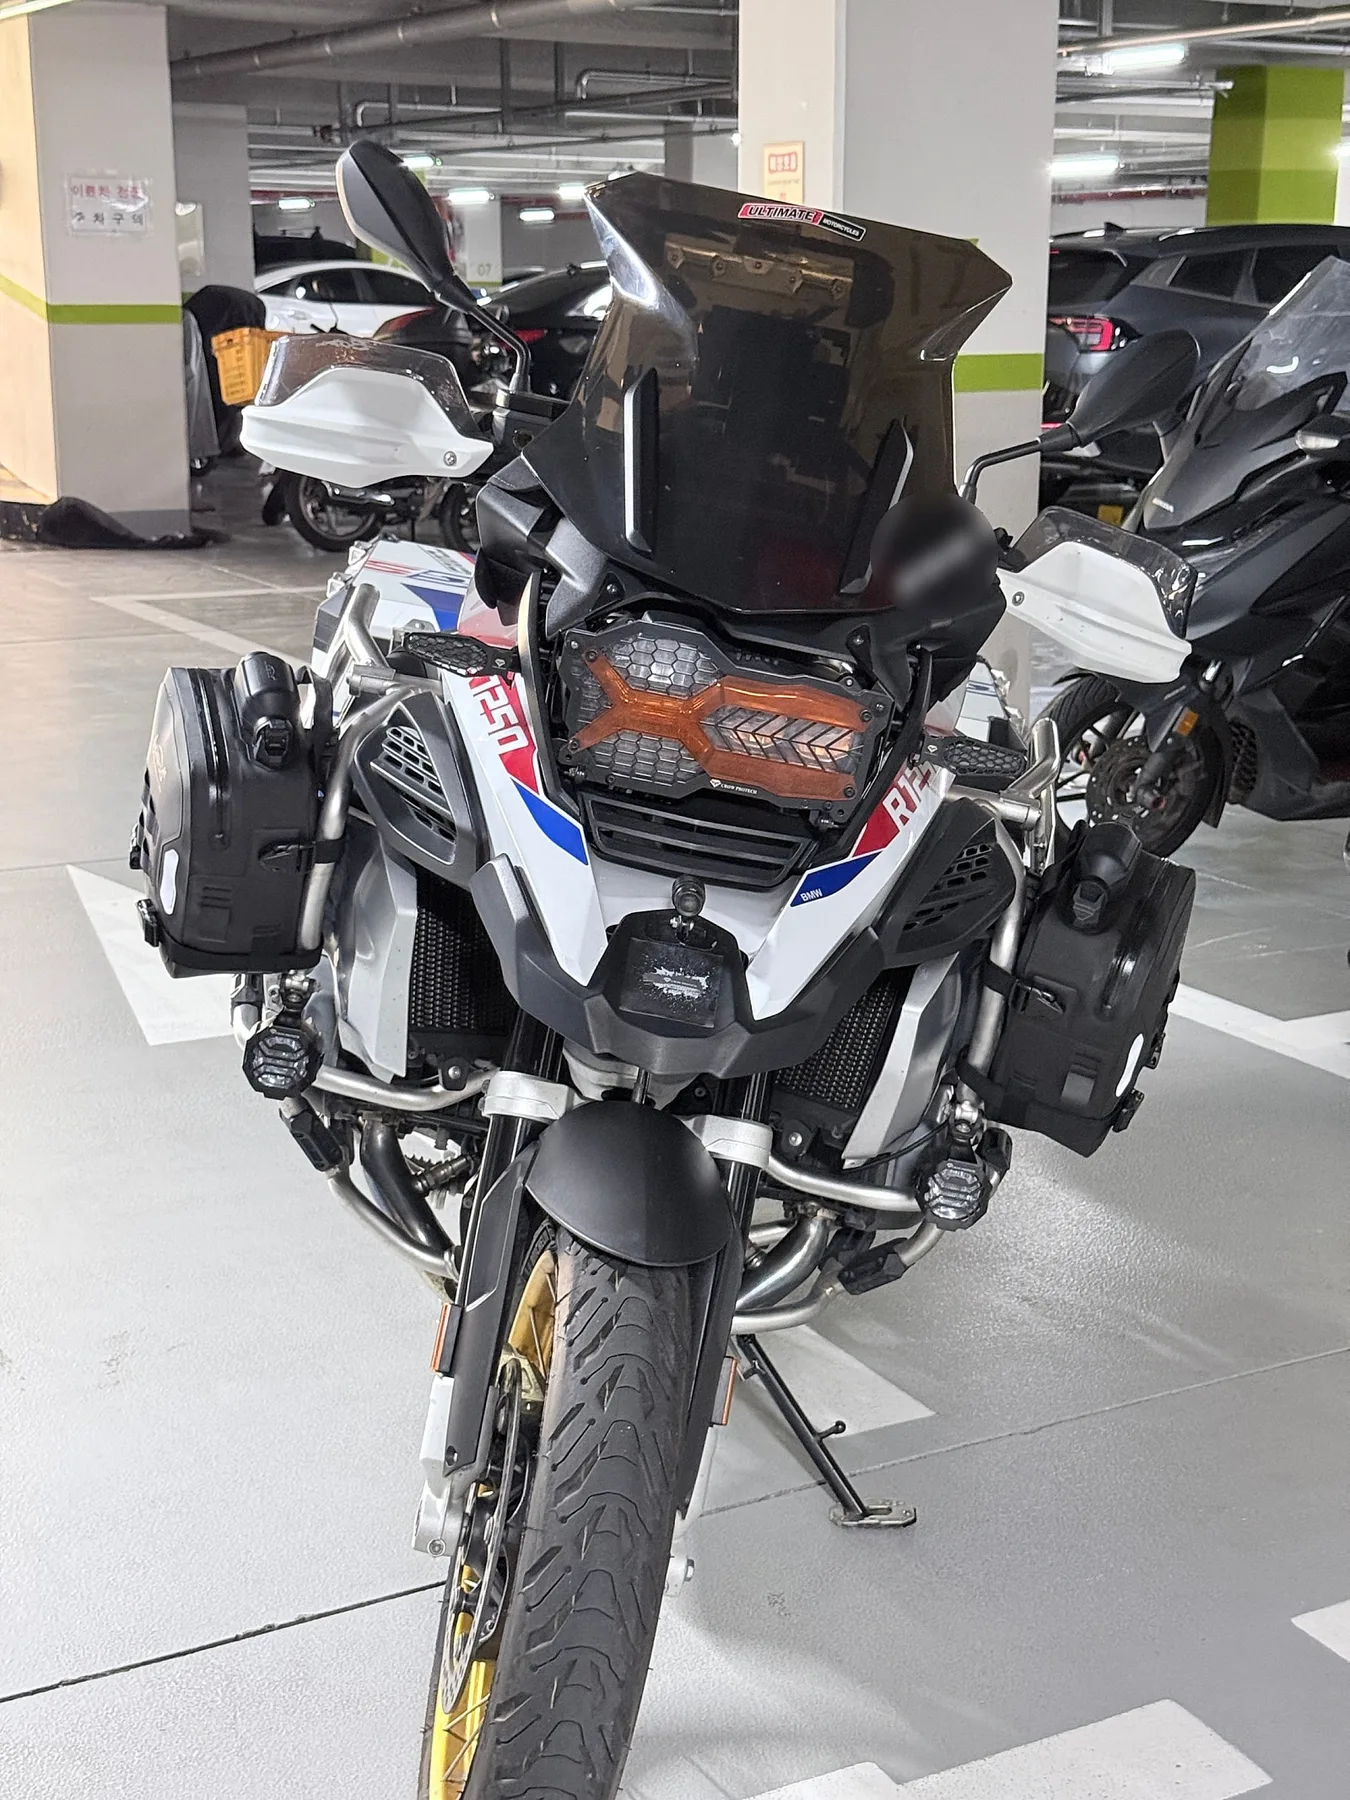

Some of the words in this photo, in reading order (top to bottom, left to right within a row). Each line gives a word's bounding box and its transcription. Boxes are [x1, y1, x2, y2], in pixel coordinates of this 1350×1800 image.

[747, 205, 815, 222] ULTIMATE
[822, 217, 861, 237] MOTORCYCLES
[476, 262, 492, 277] 07
[469, 674, 530, 756] 1250
[800, 887, 823, 901] BMW
